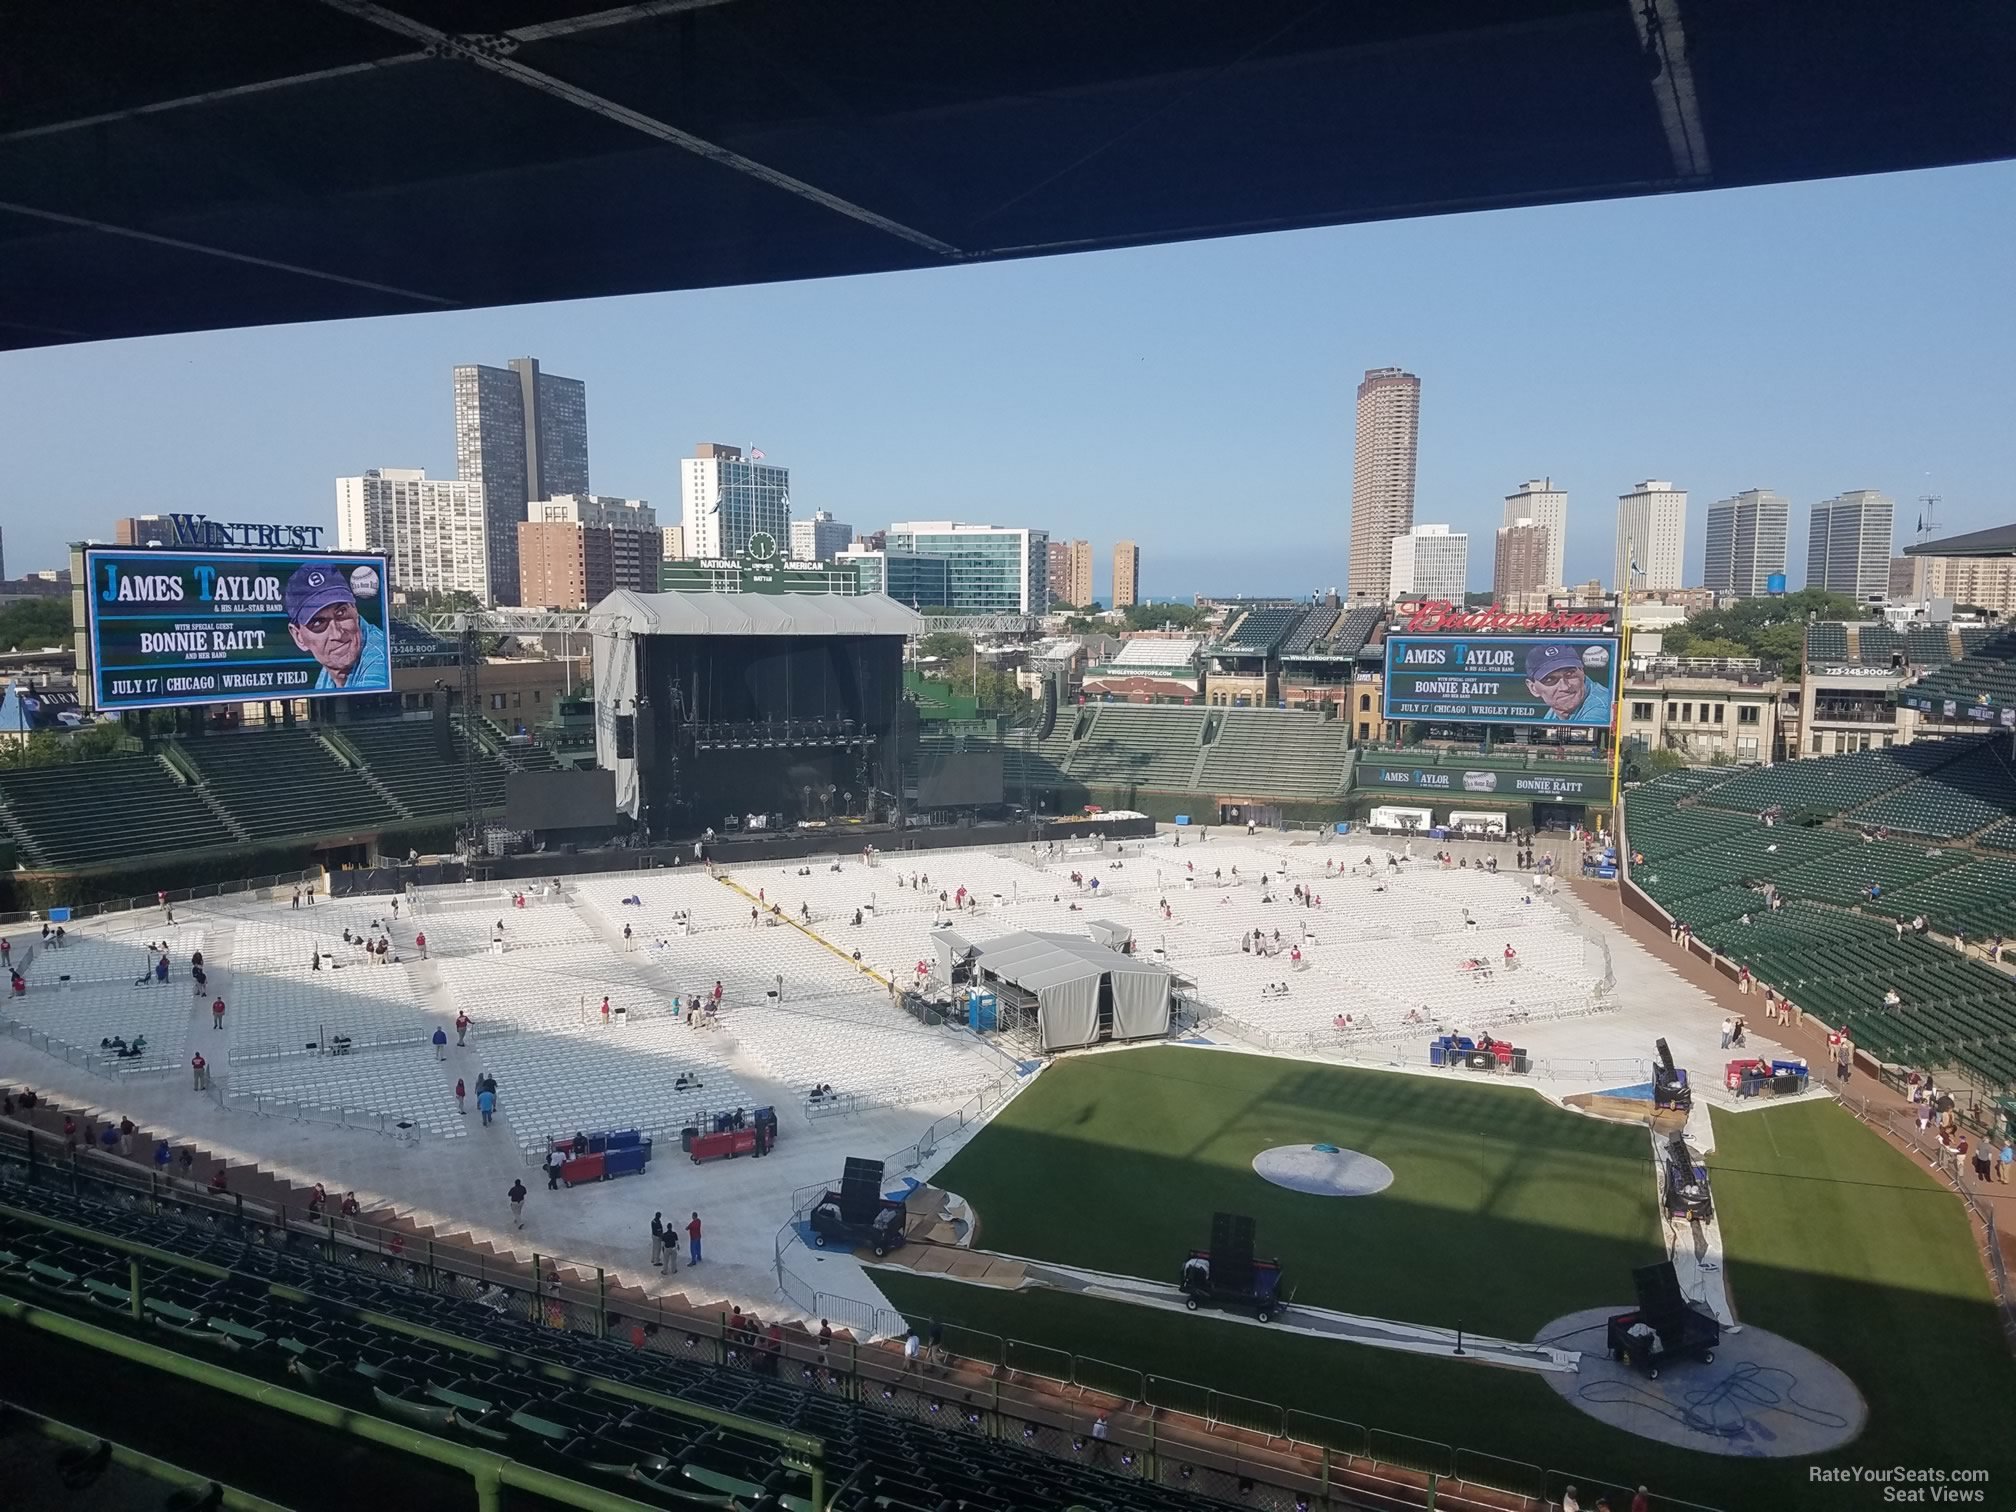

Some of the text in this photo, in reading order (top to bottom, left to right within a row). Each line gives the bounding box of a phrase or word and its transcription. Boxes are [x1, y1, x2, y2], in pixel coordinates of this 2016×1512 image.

[169, 513, 324, 548] WINTRUST
[700, 560, 742, 569] NATIONAL
[783, 561, 824, 570] AMERICAN
[102, 564, 282, 602] JAMES TAYLOR
[214, 604, 283, 612] & HIS ALL-STAR BAND
[1400, 599, 1610, 632] Budweiser
[174, 623, 191, 631] WITH
[192, 623, 215, 631] SPECIAL
[140, 630, 266, 653] BONNIE RAITT
[1395, 643, 1515, 666] JAMES TAYLOR
[111, 679, 158, 695] JULY 17
[166, 676, 215, 692] CHICAGO
[222, 671, 308, 688] WRIGLEY FIELD
[1415, 681, 1500, 695] BONNIE RAITT
[1400, 703, 1429, 712] JULY 17
[1433, 705, 1466, 714] CHICAGO
[1471, 706, 1535, 716] WRIGLEY FIELD
[1379, 768, 1409, 782] JAMES
[1413, 769, 1450, 784] TAYLOR
[1516, 779, 1551, 790] BONNIE
[1553, 781, 1583, 792] RAITT
